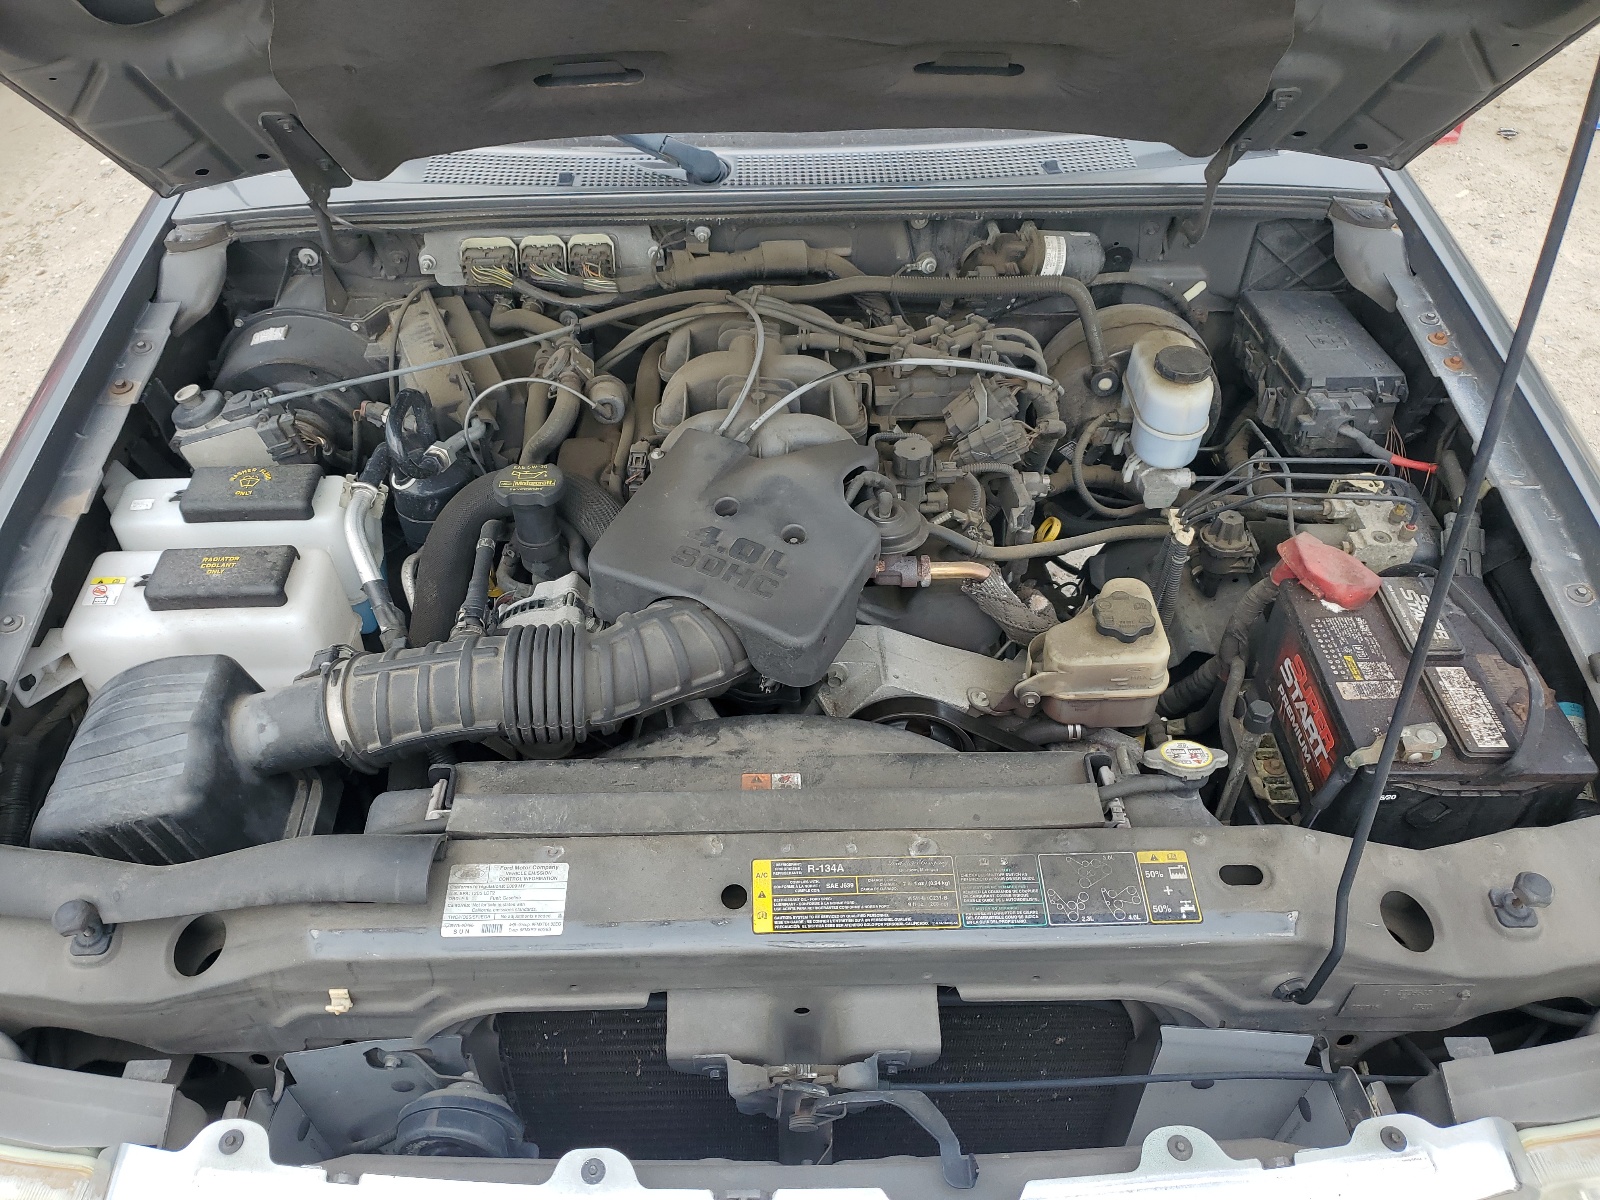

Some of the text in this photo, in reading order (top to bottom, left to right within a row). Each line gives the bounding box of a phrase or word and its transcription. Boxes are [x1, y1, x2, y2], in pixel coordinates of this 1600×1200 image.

[670, 545, 780, 600] SOHC
[686, 526, 788, 578] 4.0L
[1278, 683, 1312, 764] PREMIUM
[1279, 656, 1328, 760] START
[1293, 653, 1336, 754] SUPER
[807, 863, 844, 873] R-134A
[1144, 870, 1164, 878] 50%
[1152, 904, 1172, 913] 50%
